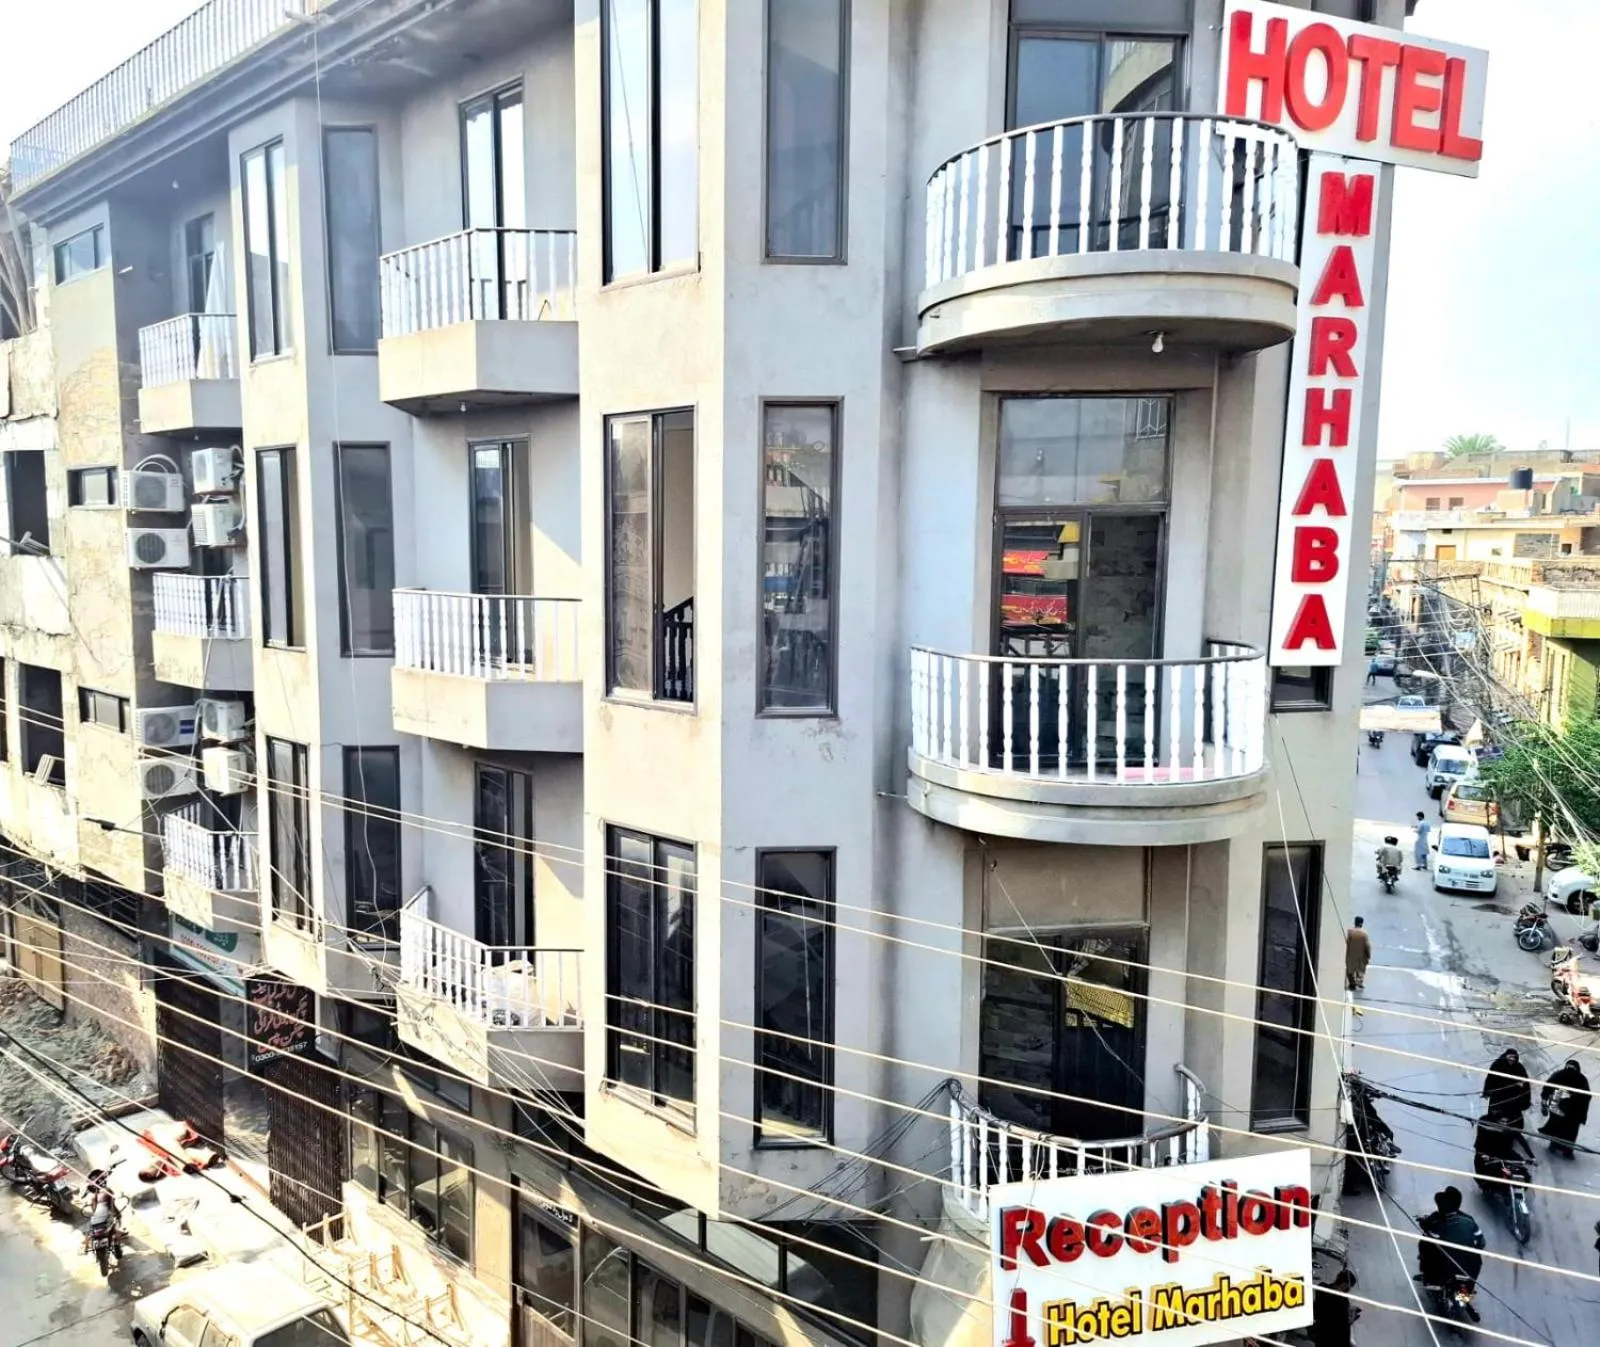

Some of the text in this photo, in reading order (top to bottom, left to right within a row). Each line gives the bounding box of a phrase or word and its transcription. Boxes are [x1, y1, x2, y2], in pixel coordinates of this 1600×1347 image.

[1226, 10, 1483, 162] HOTEL
[1281, 171, 1374, 651] MARHABA
[1000, 1179, 1310, 1271] Reception
[1043, 1265, 1304, 1347] Hotel Marhaba
